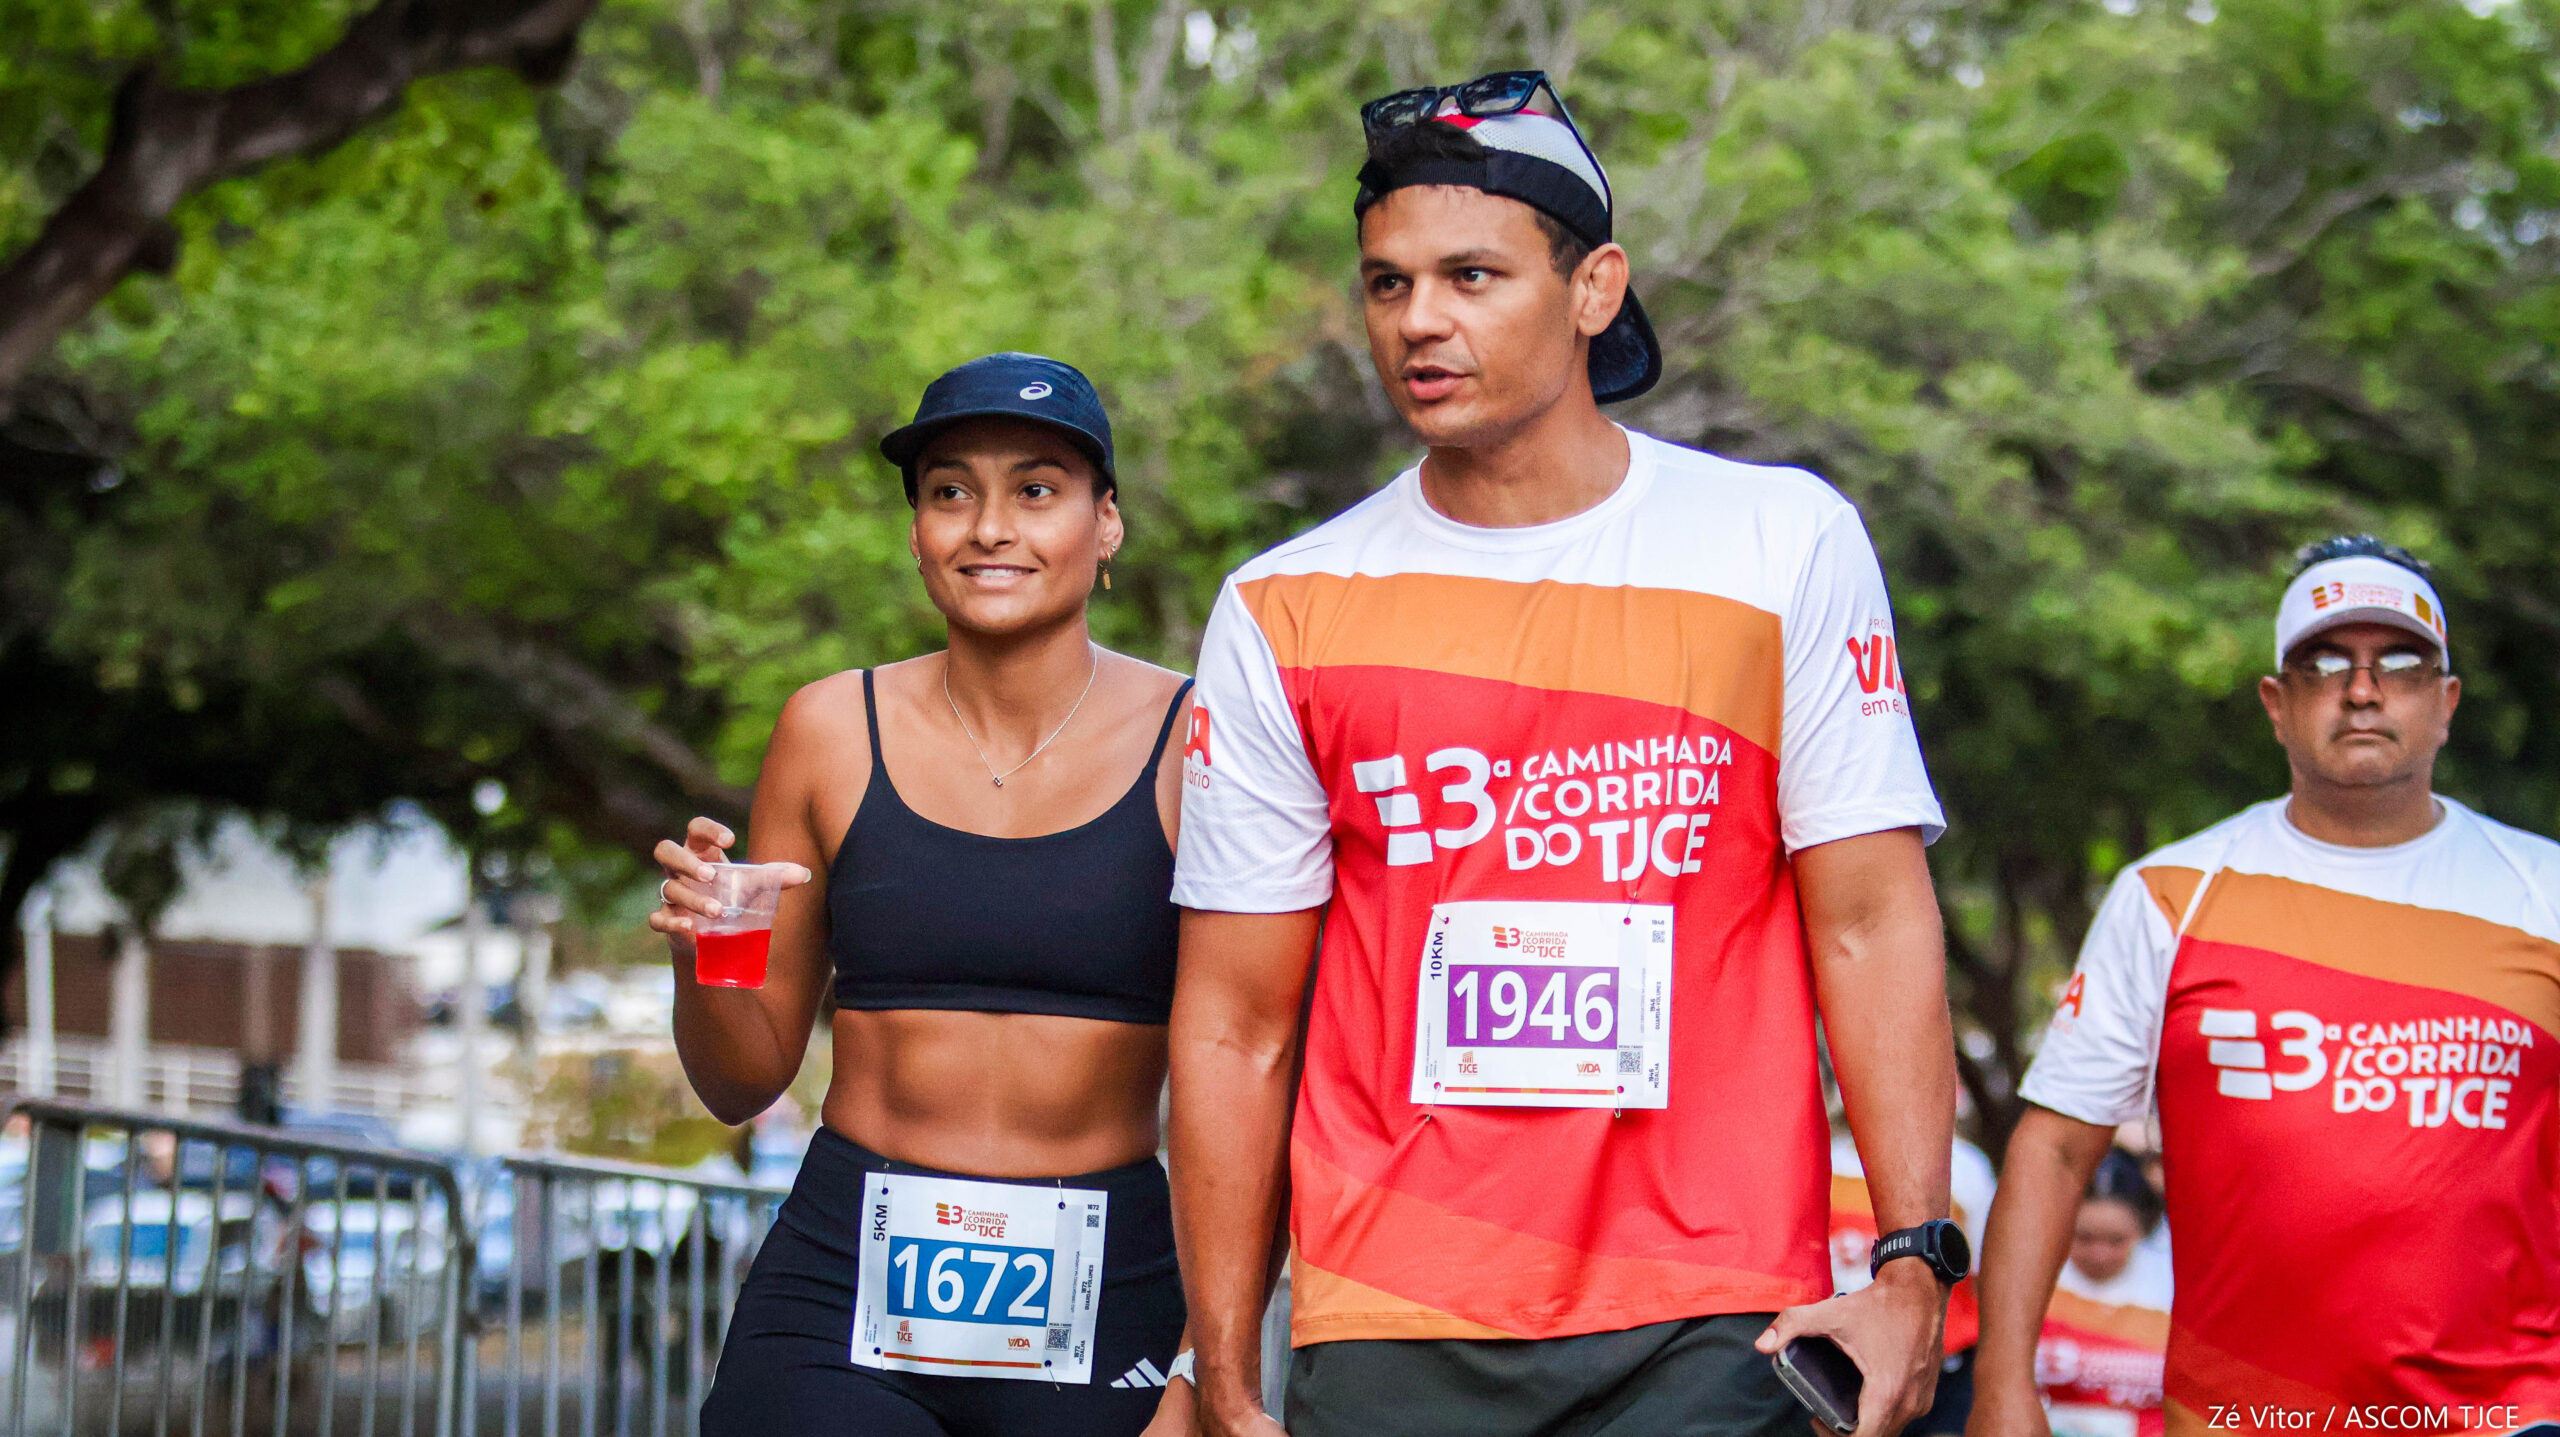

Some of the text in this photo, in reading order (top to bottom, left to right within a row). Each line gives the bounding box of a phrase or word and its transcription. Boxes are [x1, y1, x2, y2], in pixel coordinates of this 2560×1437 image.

[1862, 699, 1889, 716] em
[1522, 735, 1732, 781] CAMINHADA
[1505, 769, 1720, 825] /CORRIDA
[1505, 813, 1711, 883] DO TJCE
[1525, 930, 1568, 938] CAMINHADA
[1430, 932, 1444, 980] 10KM
[1522, 945, 1565, 958] DO TJCE
[1453, 970, 1614, 1042] 1946
[2347, 1016, 2534, 1048] CAMINHADA
[1458, 1064, 1478, 1073] TJCE
[2333, 1044, 2520, 1078] /CORRIDA
[2333, 1076, 2512, 1129] DO TJCE
[874, 1204, 888, 1241] 5KM
[964, 1223, 1005, 1238] DO TJCE
[968, 1210, 1008, 1218] CAMINHADA
[894, 1244, 1048, 1318] 1672
[897, 1331, 912, 1342] TJCE
